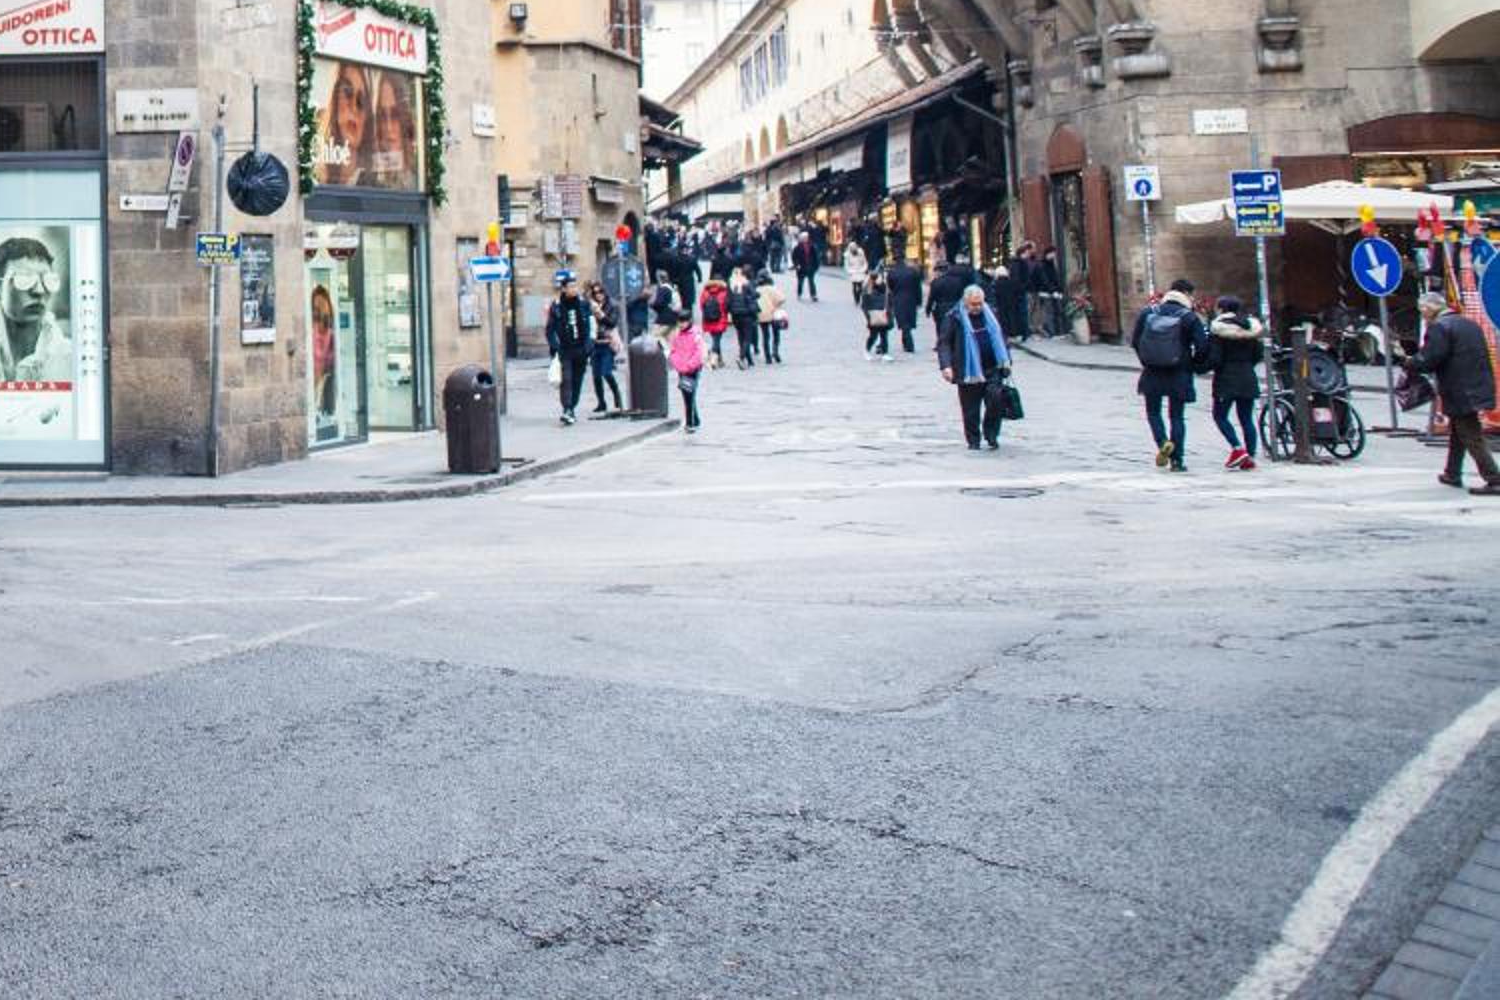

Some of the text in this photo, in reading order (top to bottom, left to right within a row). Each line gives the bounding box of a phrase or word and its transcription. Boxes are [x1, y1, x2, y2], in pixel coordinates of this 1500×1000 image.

[22, 27, 97, 46] OTTICA
[364, 23, 417, 60] OTTICA
[1262, 175, 1277, 192] P
[1267, 203, 1281, 219] P
